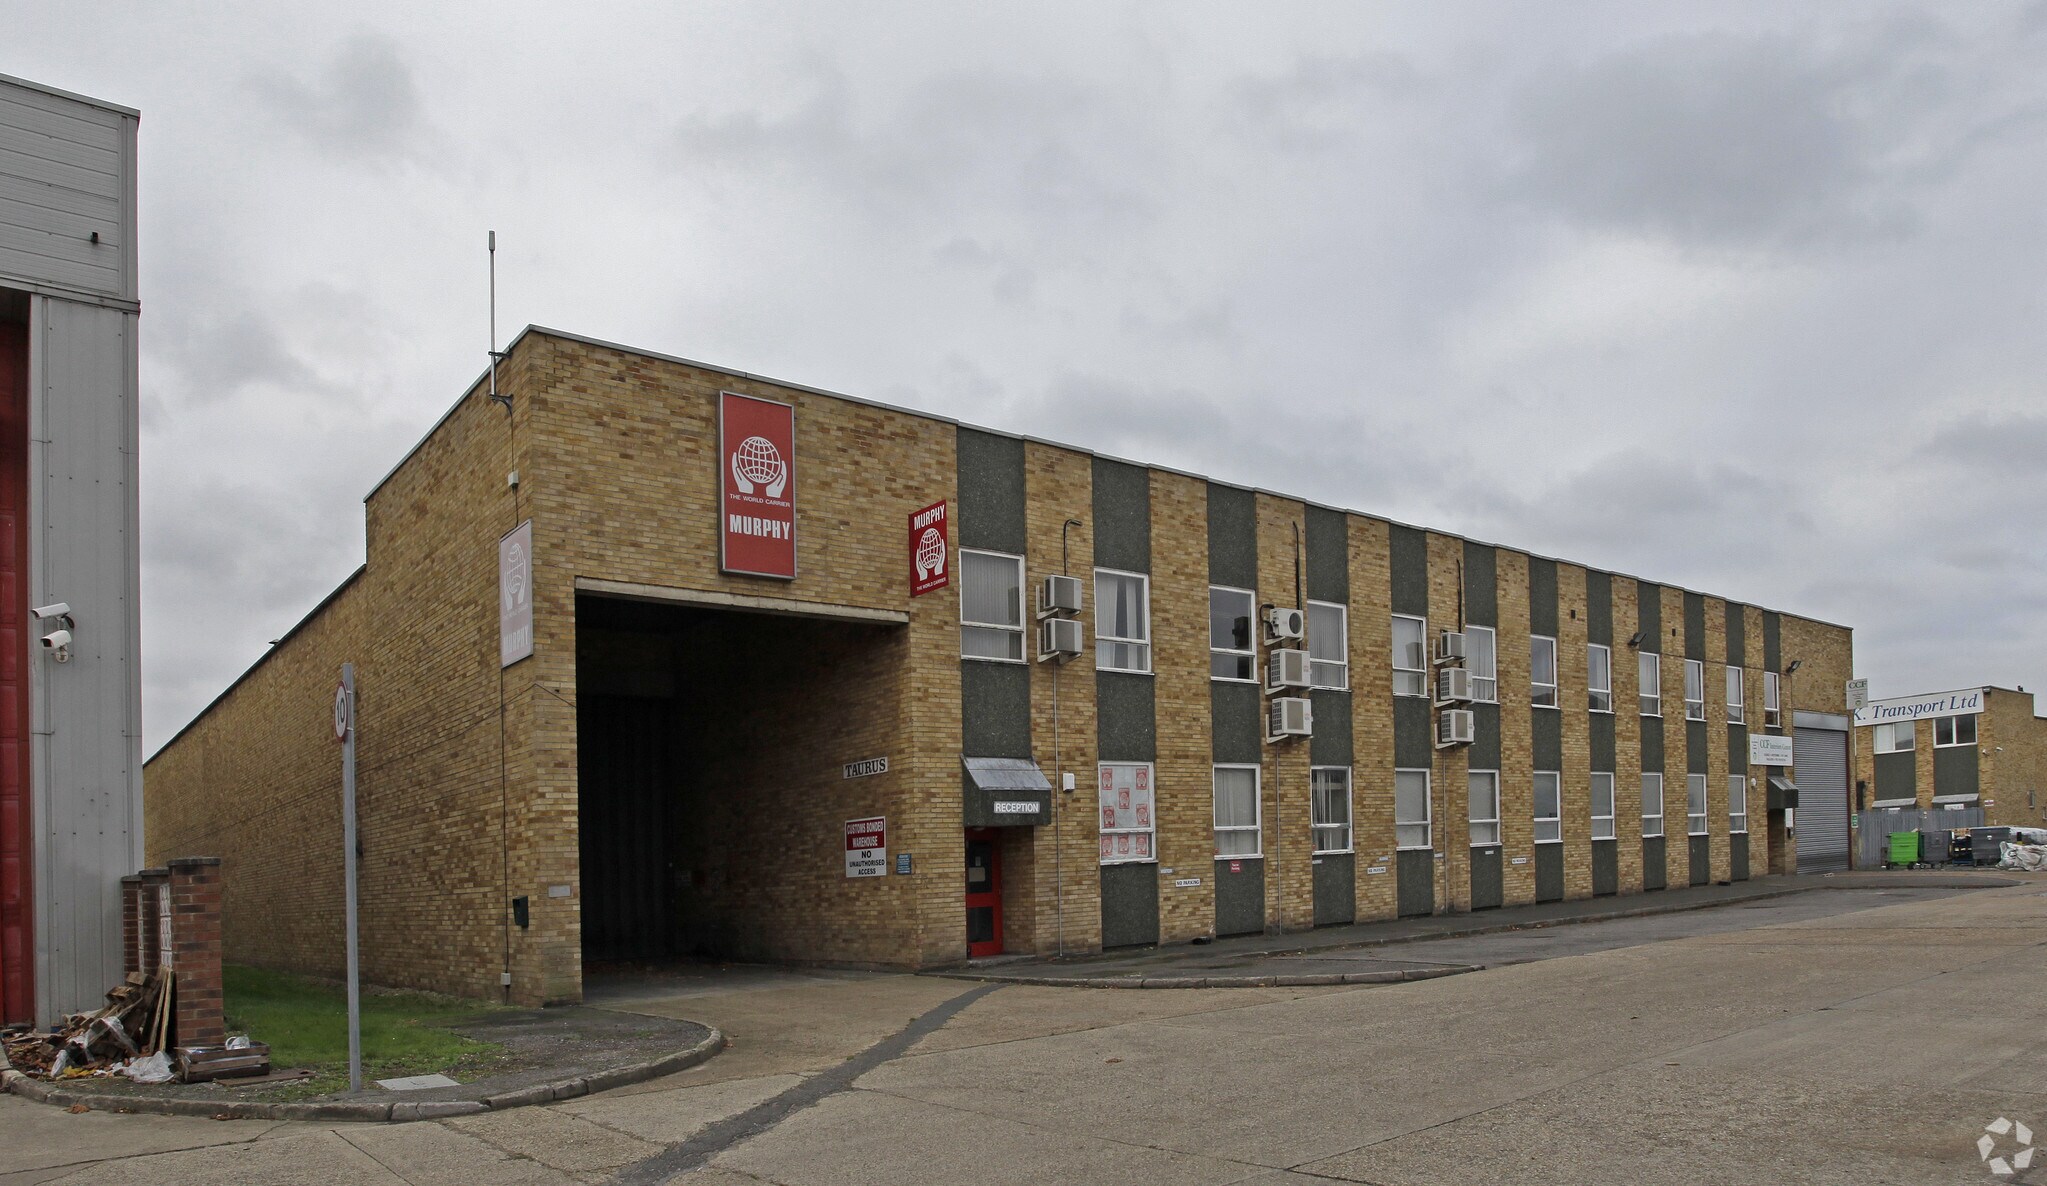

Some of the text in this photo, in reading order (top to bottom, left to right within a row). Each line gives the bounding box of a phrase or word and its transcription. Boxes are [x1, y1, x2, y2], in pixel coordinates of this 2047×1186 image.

[743, 495, 764, 504] WORLD
[765, 498, 790, 508] CARRIER
[913, 504, 945, 531] MURPHY
[729, 513, 790, 540] MURPHY
[503, 625, 529, 656] MURPHY
[1848, 680, 1867, 689] CCF
[337, 697, 346, 726] 10
[1872, 699, 1945, 719] Transport
[1949, 693, 1978, 710] Ltd
[845, 758, 886, 778] TAURUS
[995, 803, 1039, 813] RECEPTION
[847, 820, 884, 835] CUSTOMS BONDED
[852, 835, 878, 848] WAREHOUSE
[861, 850, 872, 859] NO
[849, 859, 885, 868] UNAUTHORISED
[858, 867, 876, 876] ACCESS
